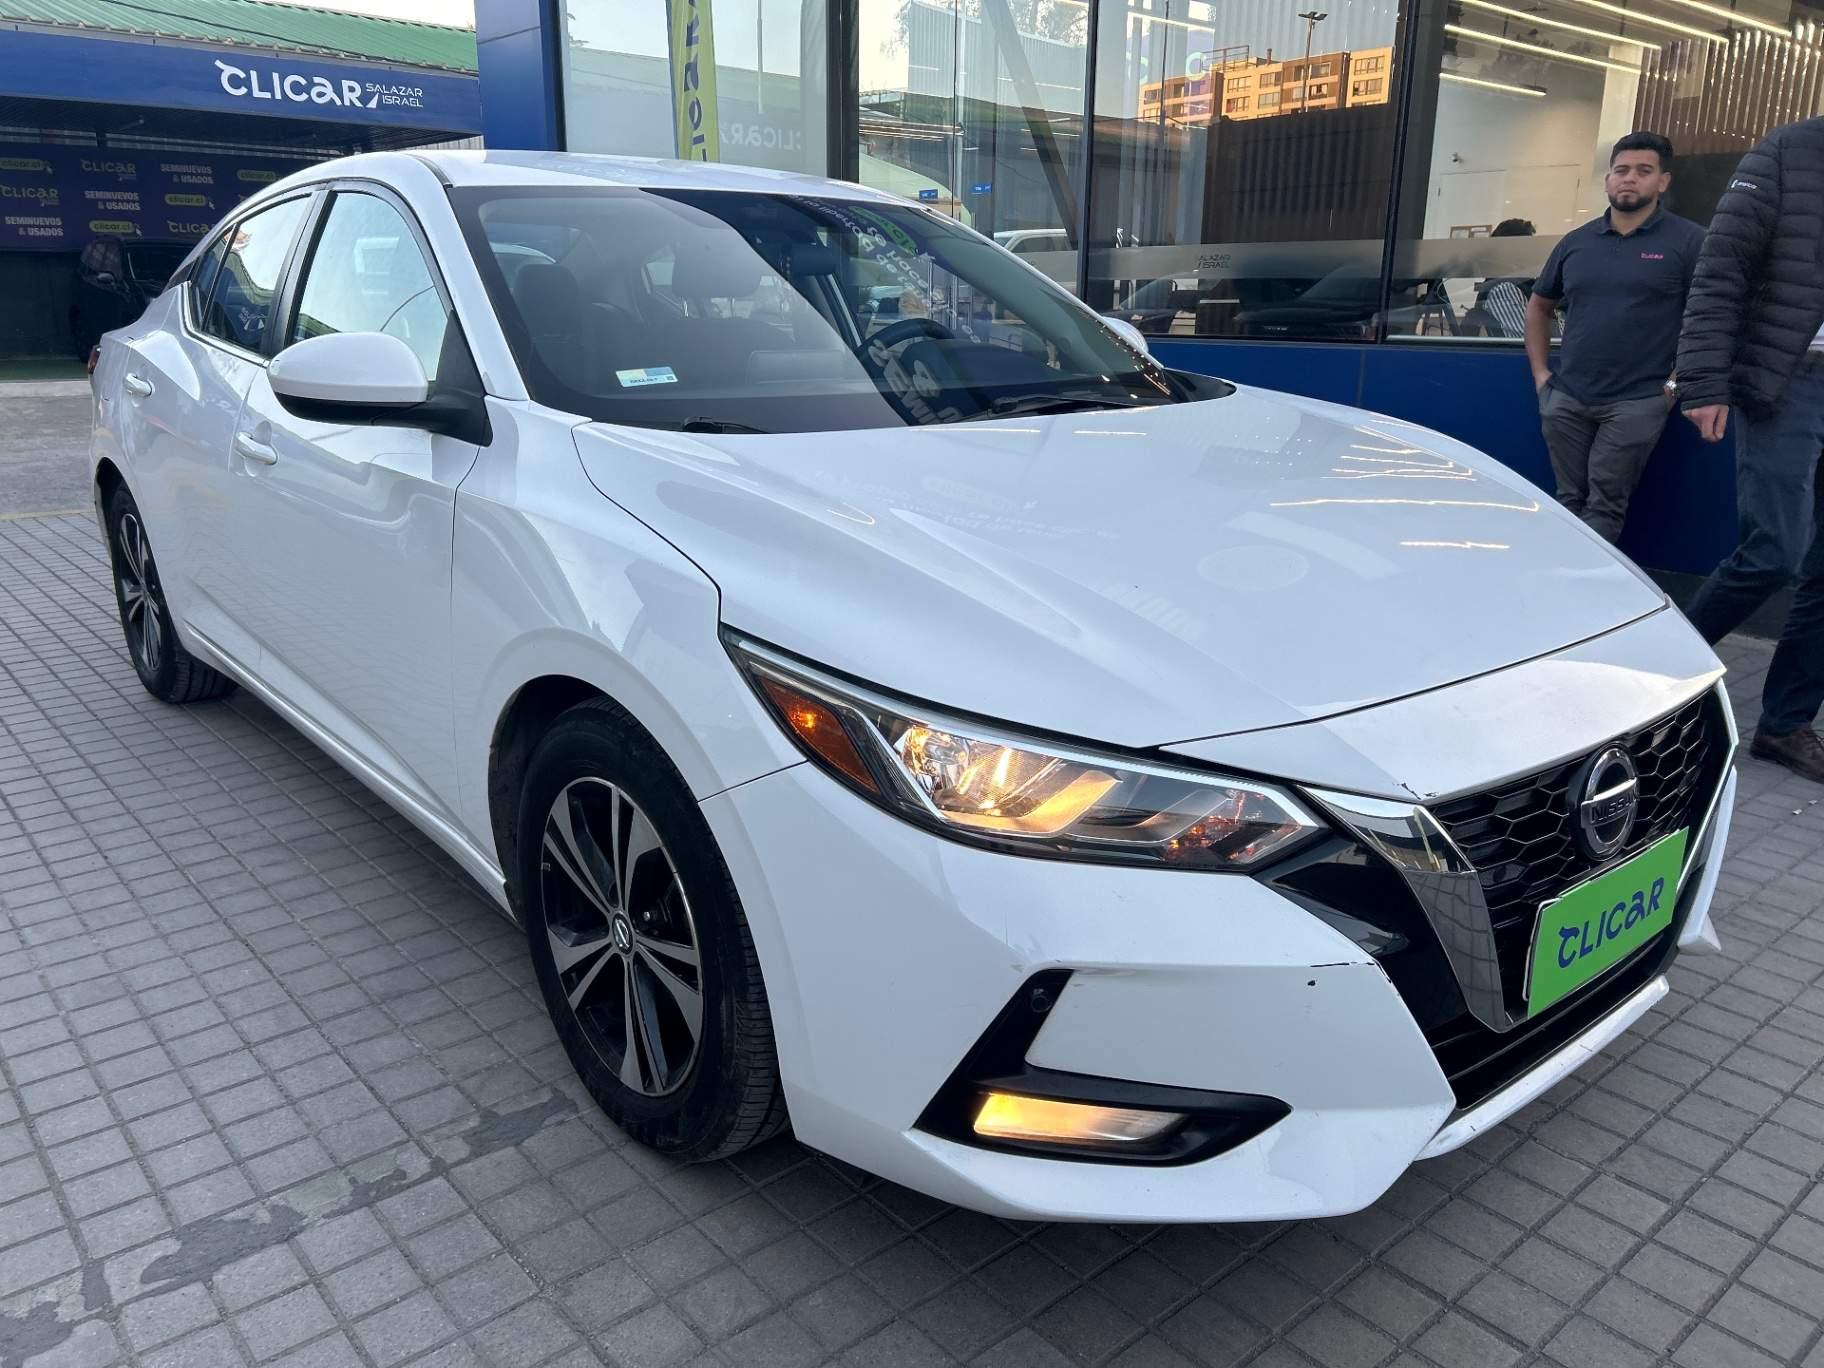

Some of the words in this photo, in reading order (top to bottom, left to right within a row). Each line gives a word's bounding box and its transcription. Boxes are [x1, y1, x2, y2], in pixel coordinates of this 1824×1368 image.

[365, 82, 423, 97] SALAZAR
[382, 95, 423, 108] ISRAEL
[106, 201, 141, 210] USADOS
[5, 216, 62, 226] SEMINUEVOS
[28, 227, 64, 236] USADOS
